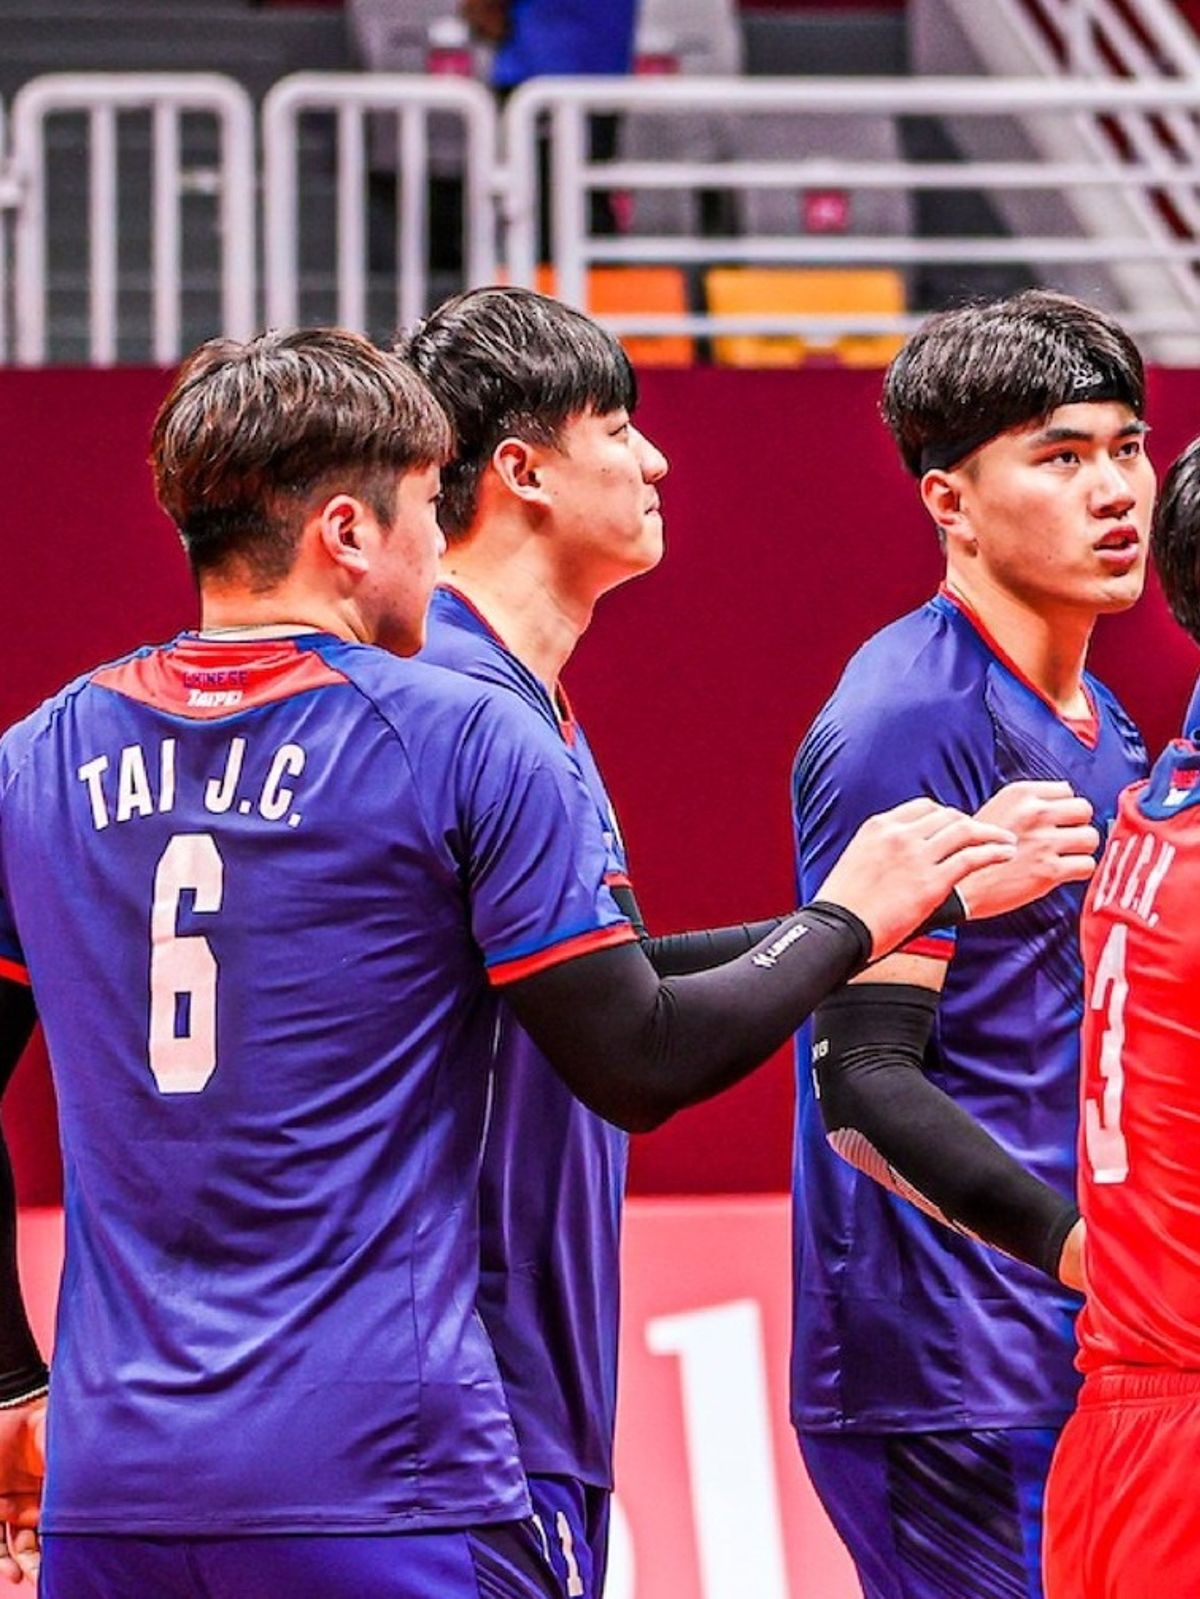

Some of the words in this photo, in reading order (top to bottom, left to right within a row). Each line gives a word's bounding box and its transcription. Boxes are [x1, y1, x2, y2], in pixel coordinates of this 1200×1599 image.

[77, 737, 177, 830] TAI
[204, 736, 306, 828] J.C.
[149, 833, 224, 1094] 6
[1086, 922, 1130, 1184] 3
